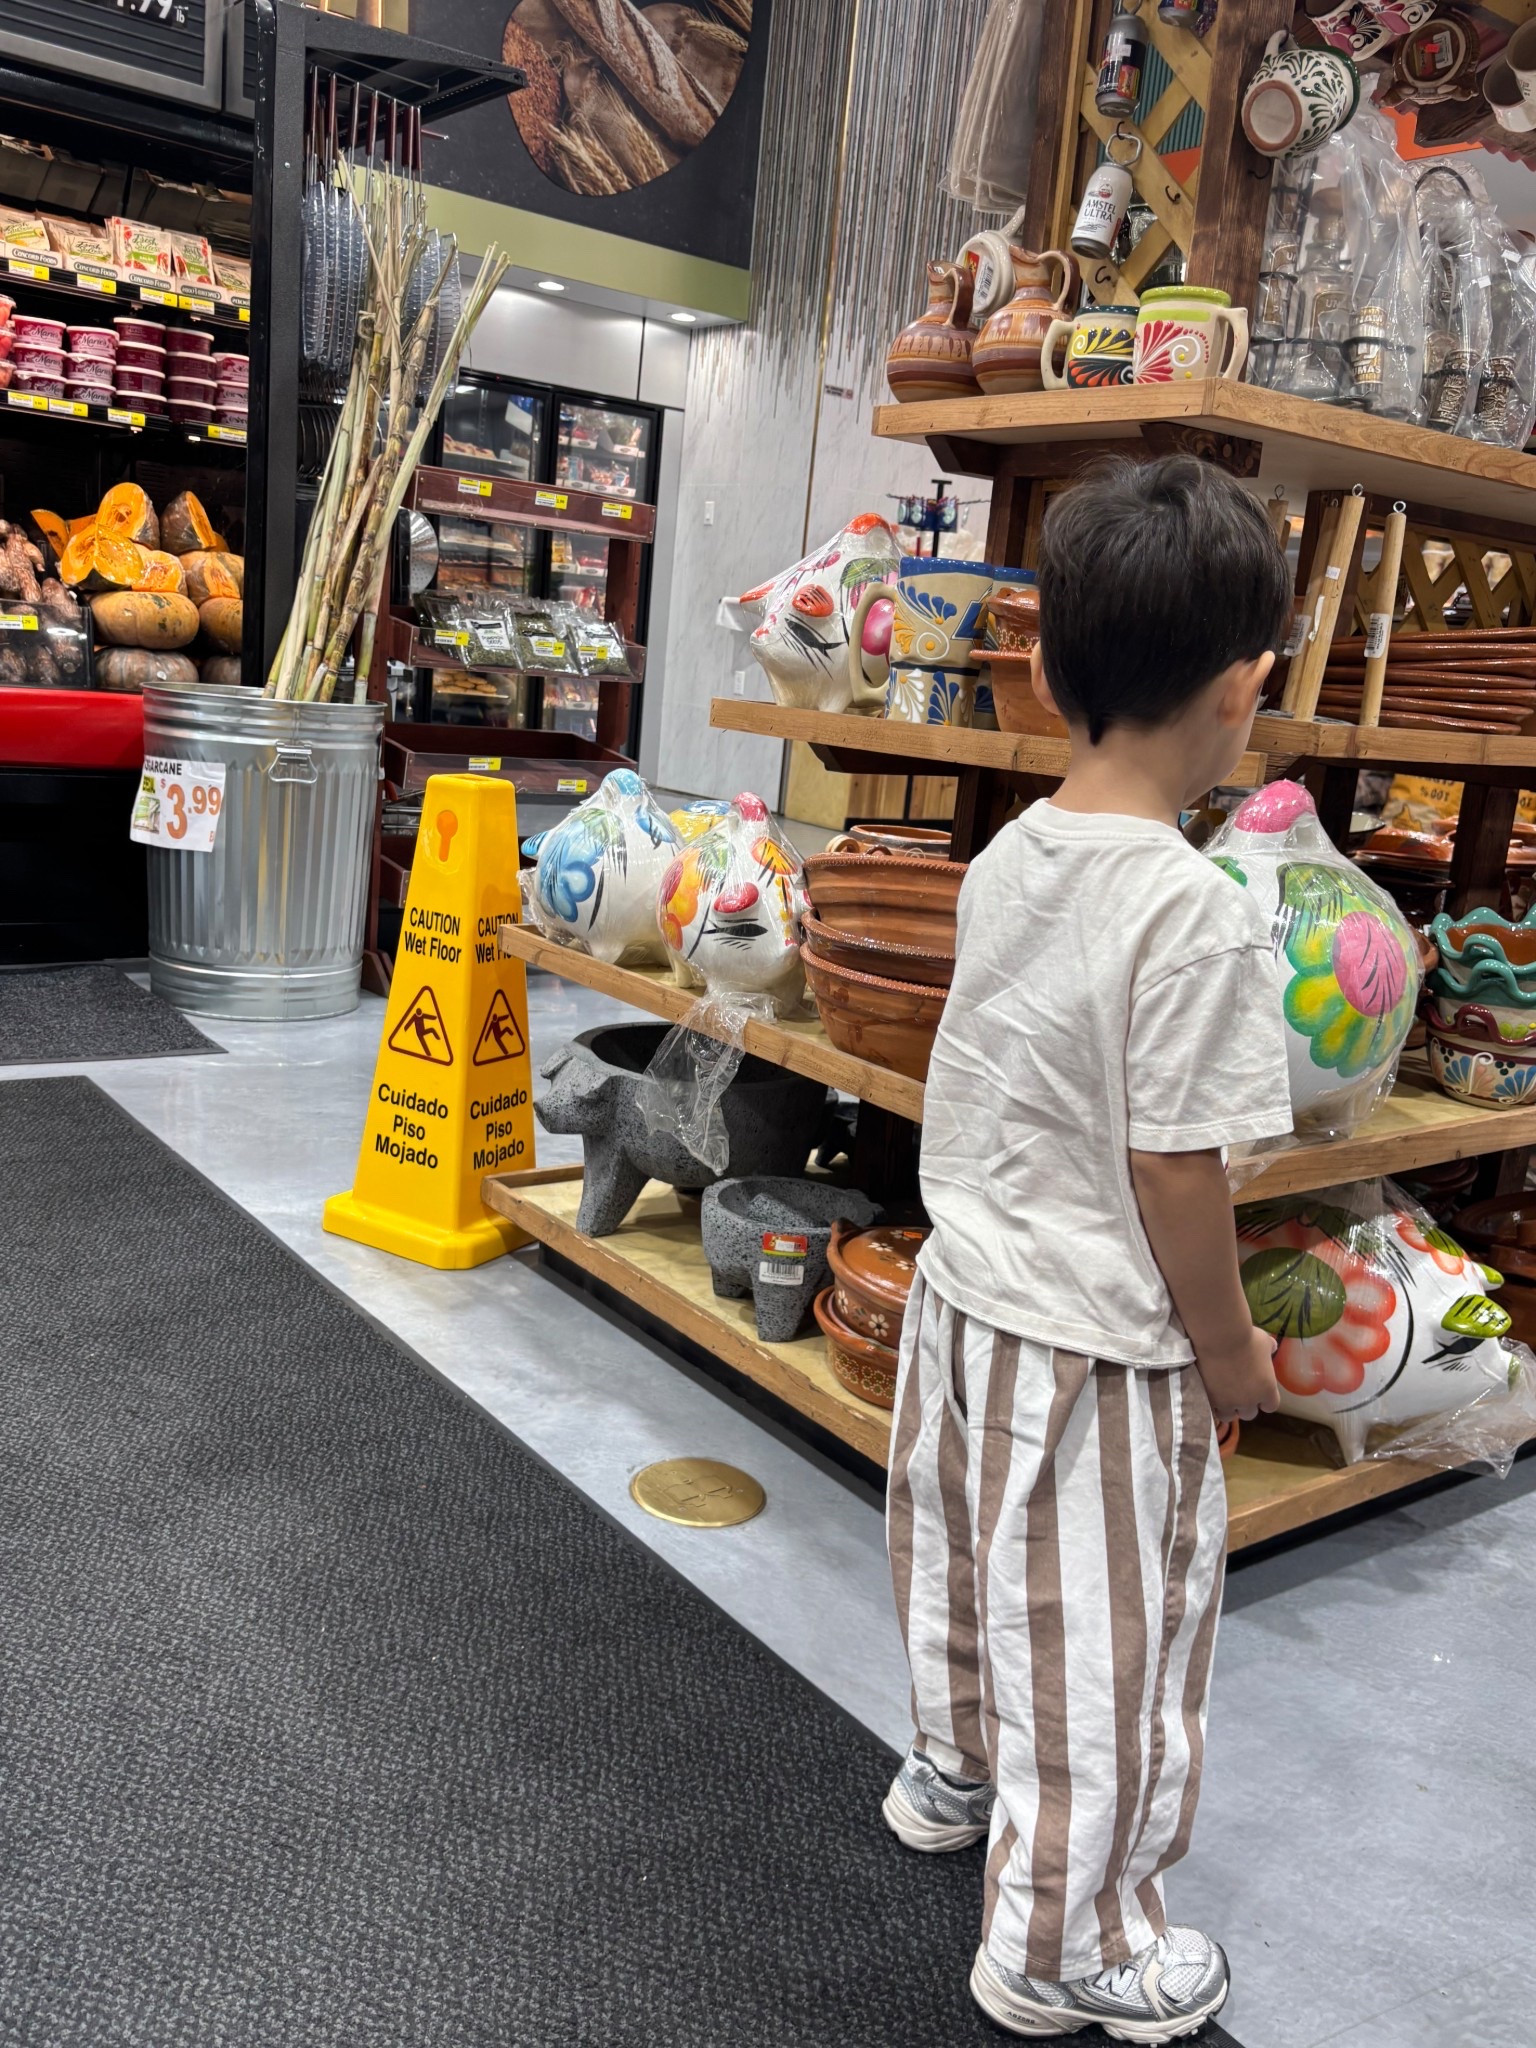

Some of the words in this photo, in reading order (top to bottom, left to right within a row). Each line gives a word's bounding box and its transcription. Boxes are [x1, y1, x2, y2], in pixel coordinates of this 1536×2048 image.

[1083, 208, 1113, 223] ULTRA
[1085, 199, 1116, 215] AMSTEL
[409, 907, 461, 937] CAUTION
[404, 931, 427, 957] Wet
[429, 938, 463, 965] Floor
[475, 943, 495, 965] Wet
[378, 1083, 449, 1119] Cuidado
[470, 1087, 528, 1120] Cuidado
[392, 1114, 426, 1141] Piso
[485, 1120, 513, 1142] Piso
[375, 1133, 439, 1170] Mojado
[472, 1138, 525, 1171] Mojado
